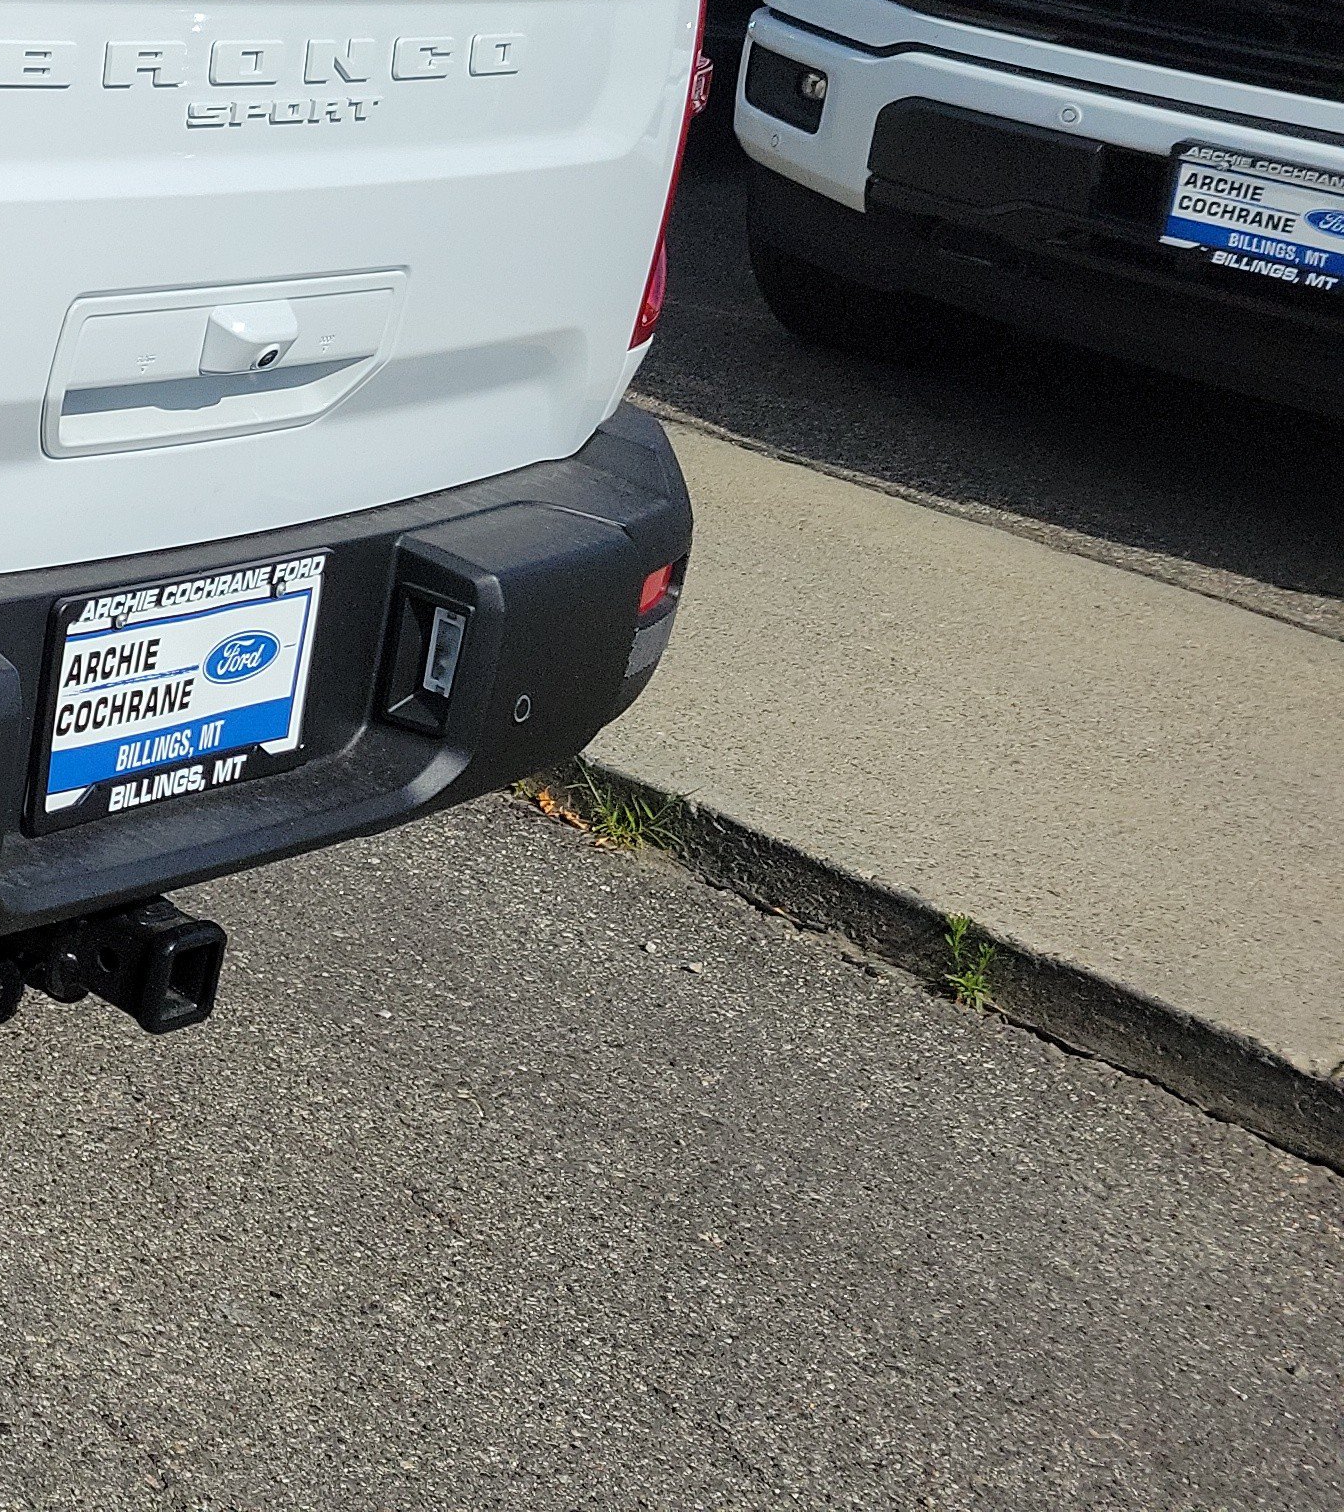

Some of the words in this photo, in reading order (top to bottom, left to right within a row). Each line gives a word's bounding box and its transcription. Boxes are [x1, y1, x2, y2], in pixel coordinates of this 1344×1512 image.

[184, 95, 382, 129] SPORT
[1184, 146, 1254, 169] ARCHIE
[1184, 172, 1265, 203] ARCHIE
[1178, 195, 1297, 234] COCHRANE
[1211, 250, 1301, 285] BILLINGS,
[1305, 272, 1339, 291] MT
[1227, 233, 1301, 264] BILLINGS,
[1304, 251, 1330, 268] MT
[79, 588, 159, 622] ARCHIE
[160, 566, 273, 609] COCHRANE
[272, 555, 326, 585] FORD
[63, 638, 162, 689] ARCHIE
[216, 638, 264, 676] Ford
[55, 678, 196, 737] COCHRANE
[115, 726, 194, 772] BILLINGS,
[198, 720, 226, 751] MT
[108, 765, 206, 812] BILLINGS,
[211, 754, 248, 786] MT
